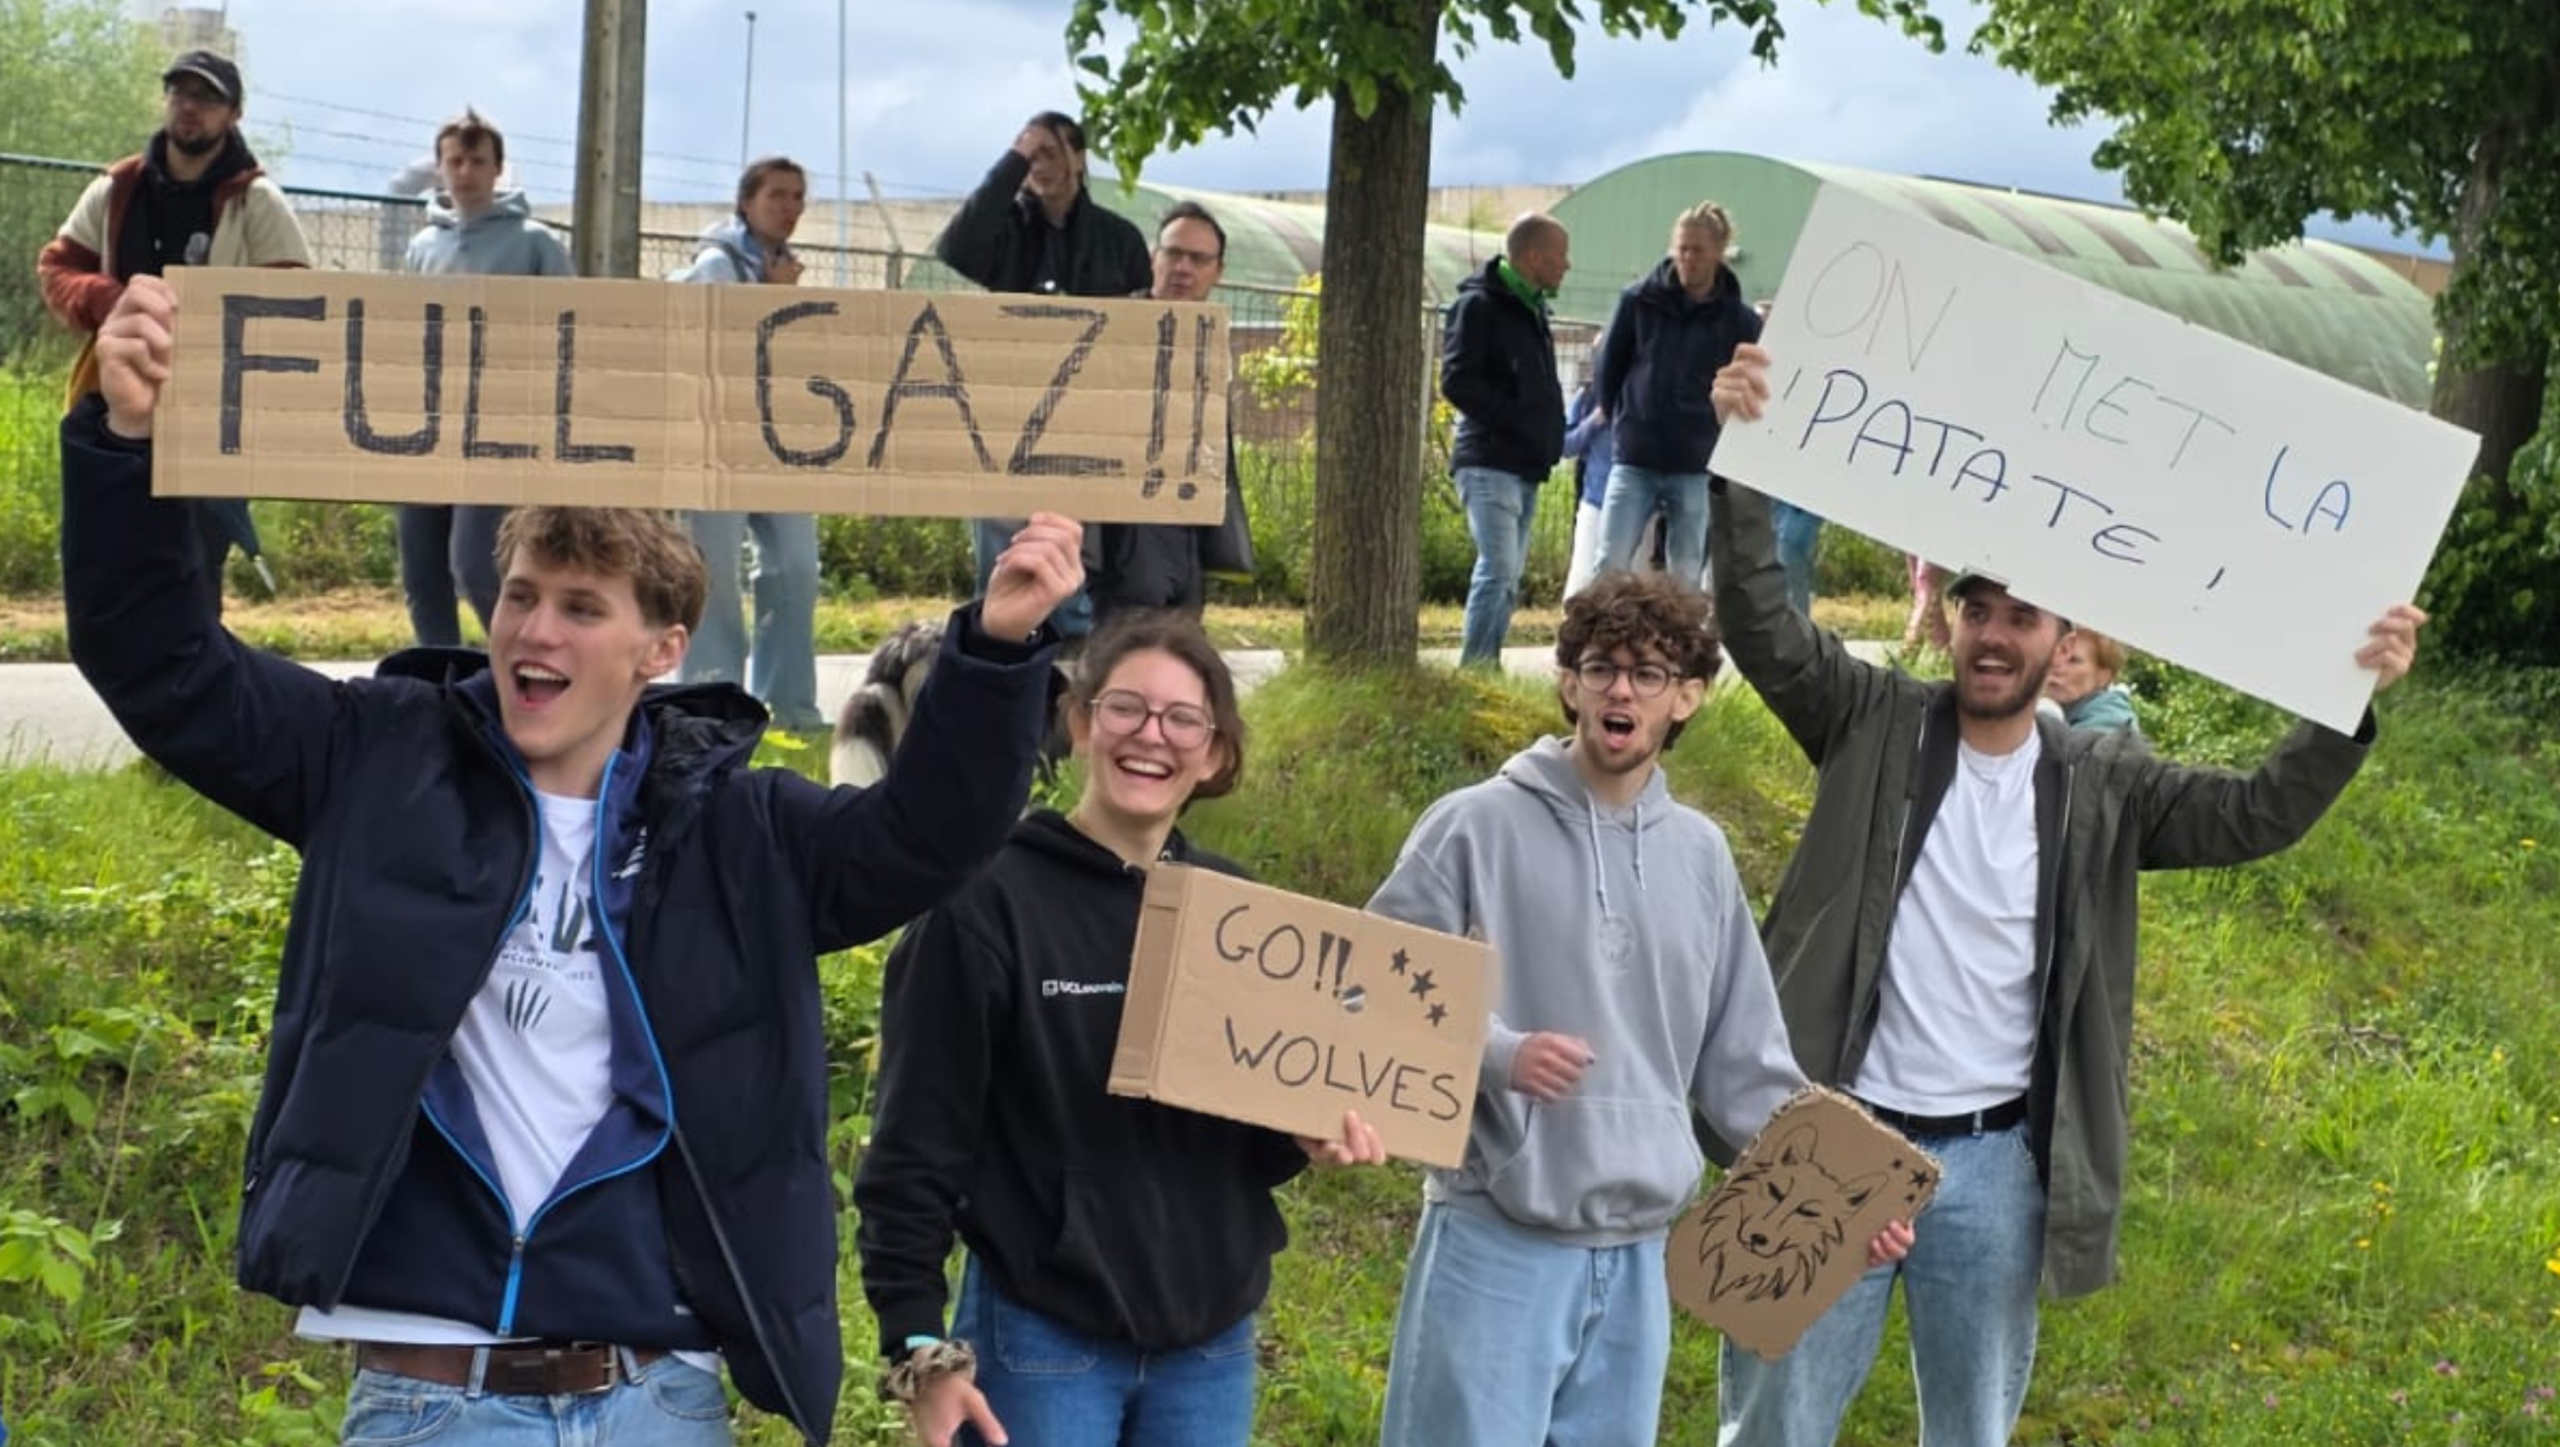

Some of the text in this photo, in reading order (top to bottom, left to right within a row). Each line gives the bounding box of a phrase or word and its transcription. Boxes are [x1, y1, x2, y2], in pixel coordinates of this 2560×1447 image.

[220, 295, 1215, 500] FULL GAZ!!
[1804, 240, 2352, 534] ON MET LA
[1215, 904, 1353, 999] GO!!
[1224, 1015, 1462, 1121] WOLVES
